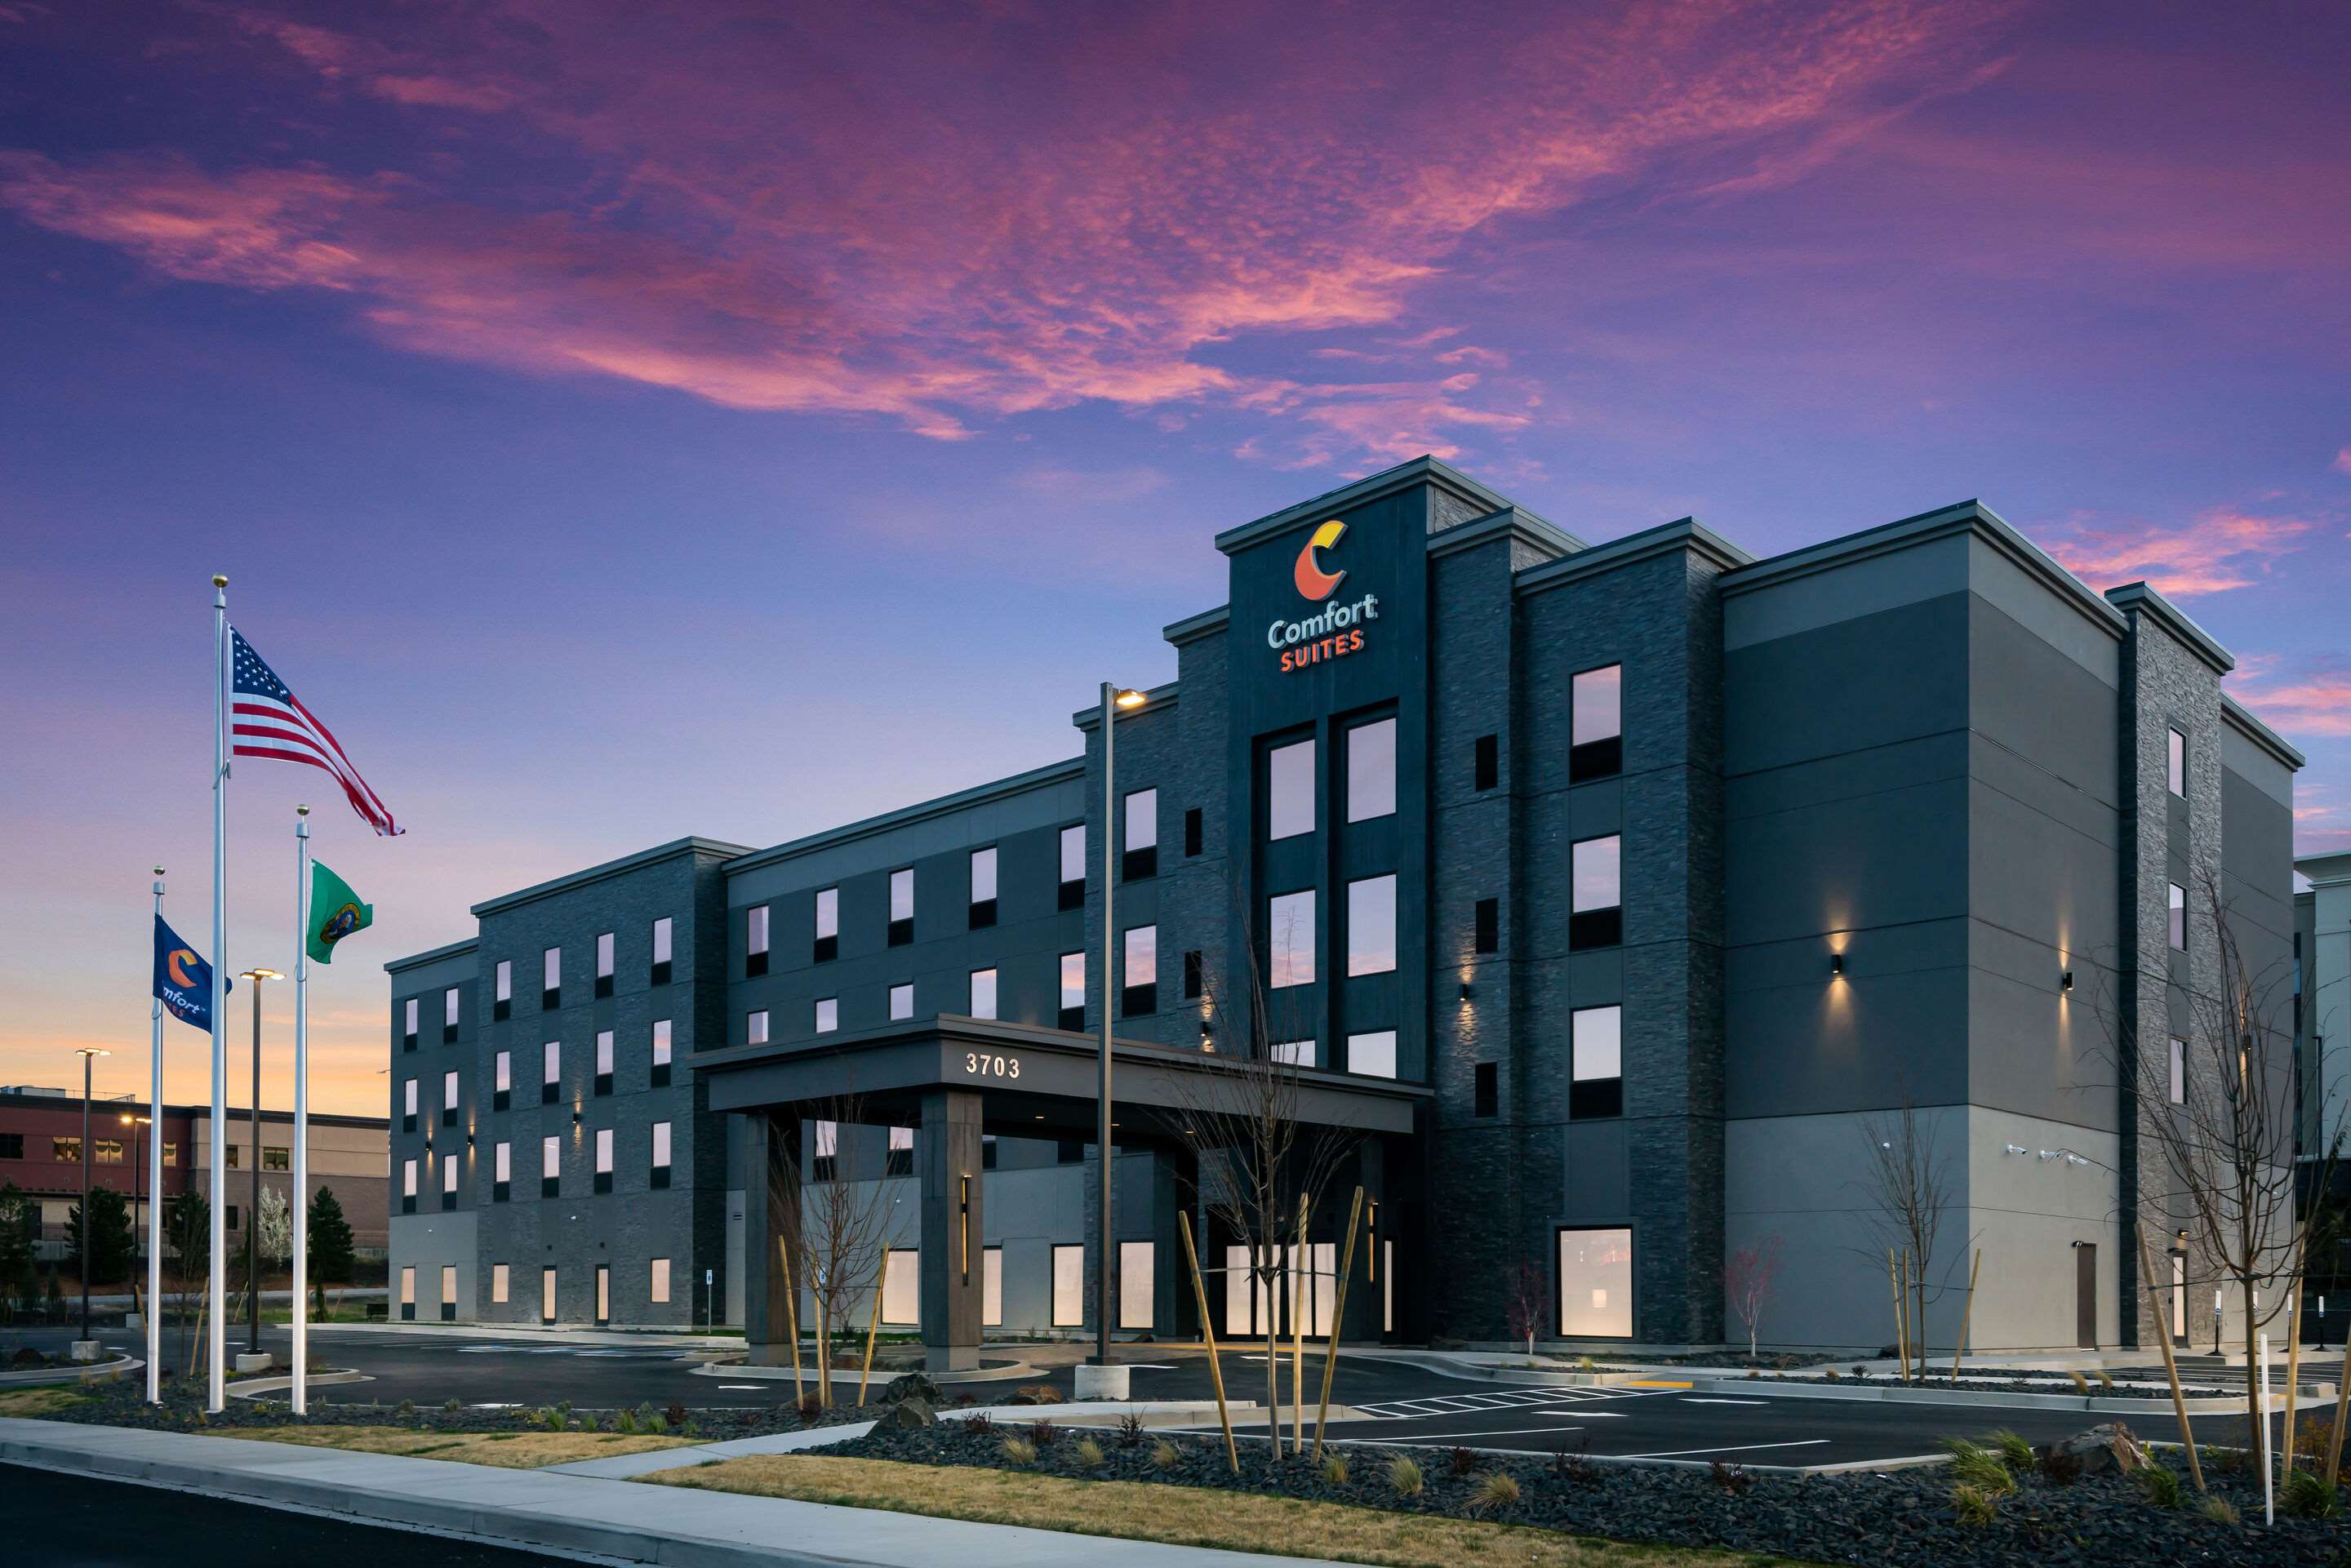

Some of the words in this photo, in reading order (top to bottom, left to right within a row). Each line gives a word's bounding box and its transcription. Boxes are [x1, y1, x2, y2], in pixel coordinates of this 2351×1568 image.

[1268, 593, 1378, 648] Comfort
[1281, 629, 1364, 673] SUITES
[163, 986, 200, 1014] mfort
[966, 1053, 1020, 1078] 3703
